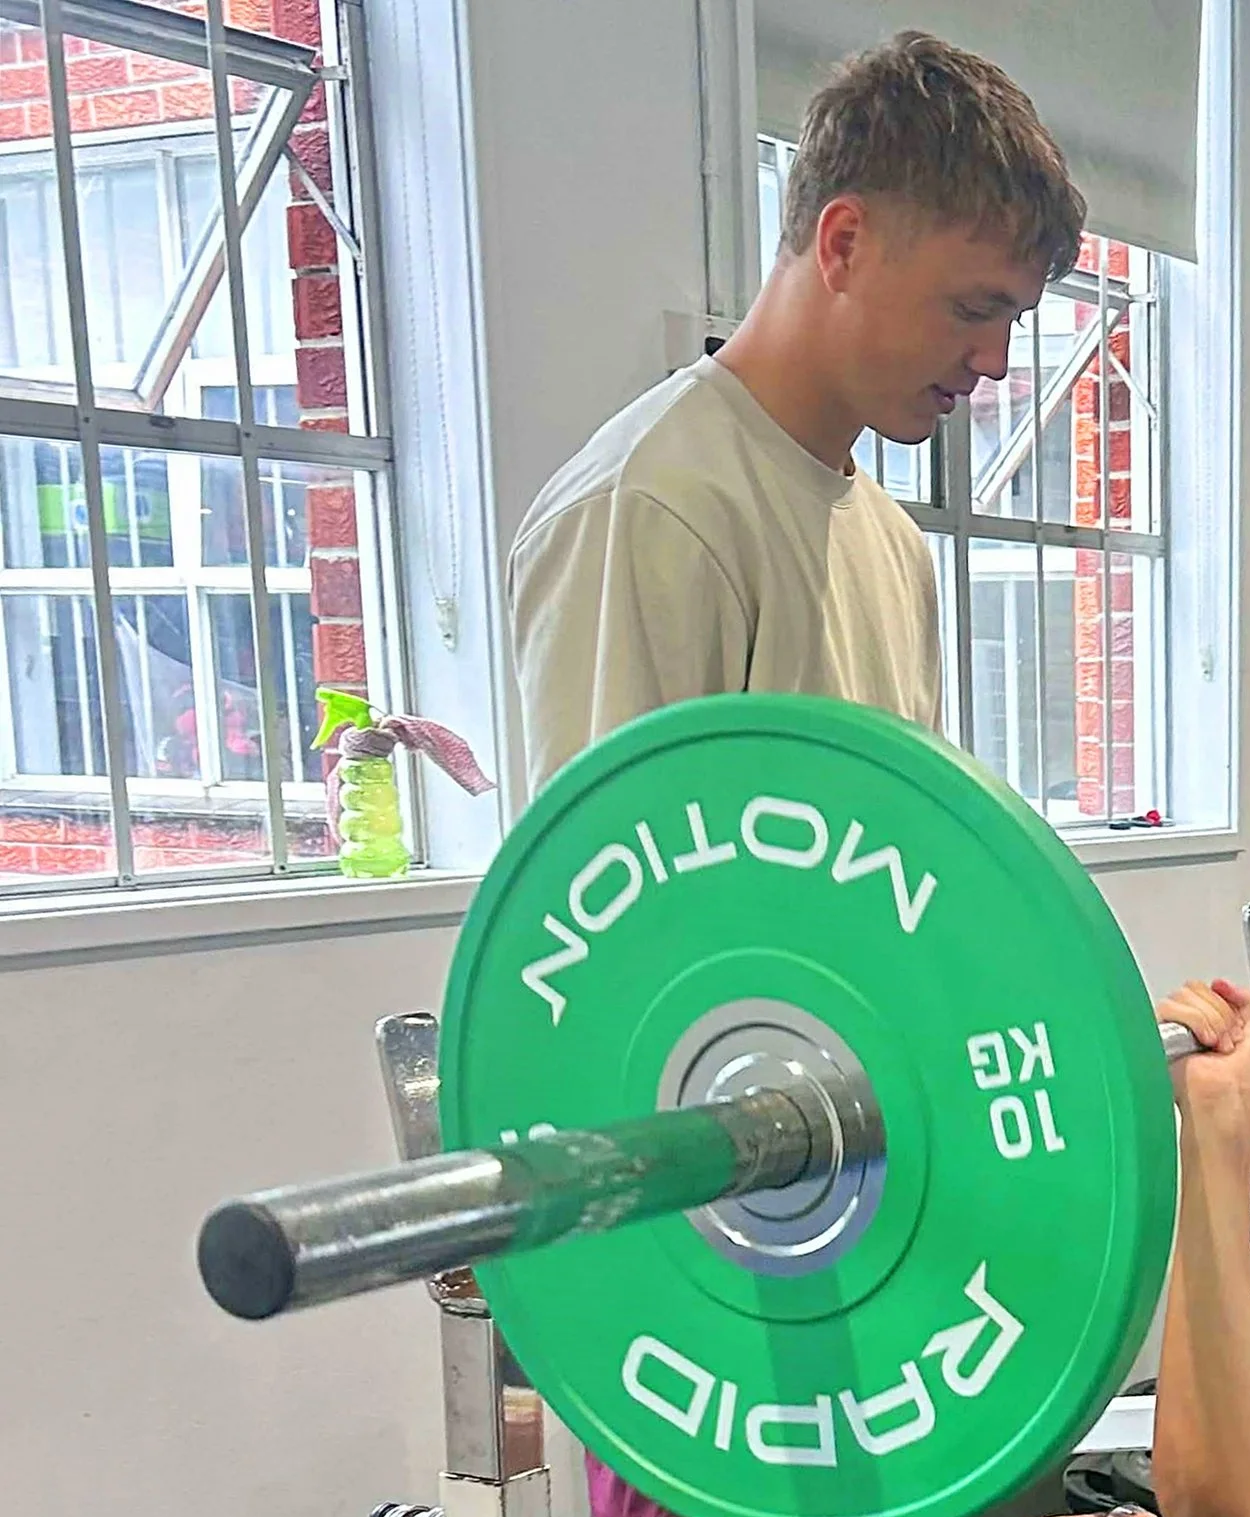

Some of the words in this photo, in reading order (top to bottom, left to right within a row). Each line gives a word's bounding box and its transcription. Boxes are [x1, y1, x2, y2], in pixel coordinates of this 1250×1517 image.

[520, 795, 938, 1026] MOTION
[966, 1022, 1056, 1089] KG
[988, 1090, 1066, 1160] 10
[621, 1261, 1025, 1467] RAPID
